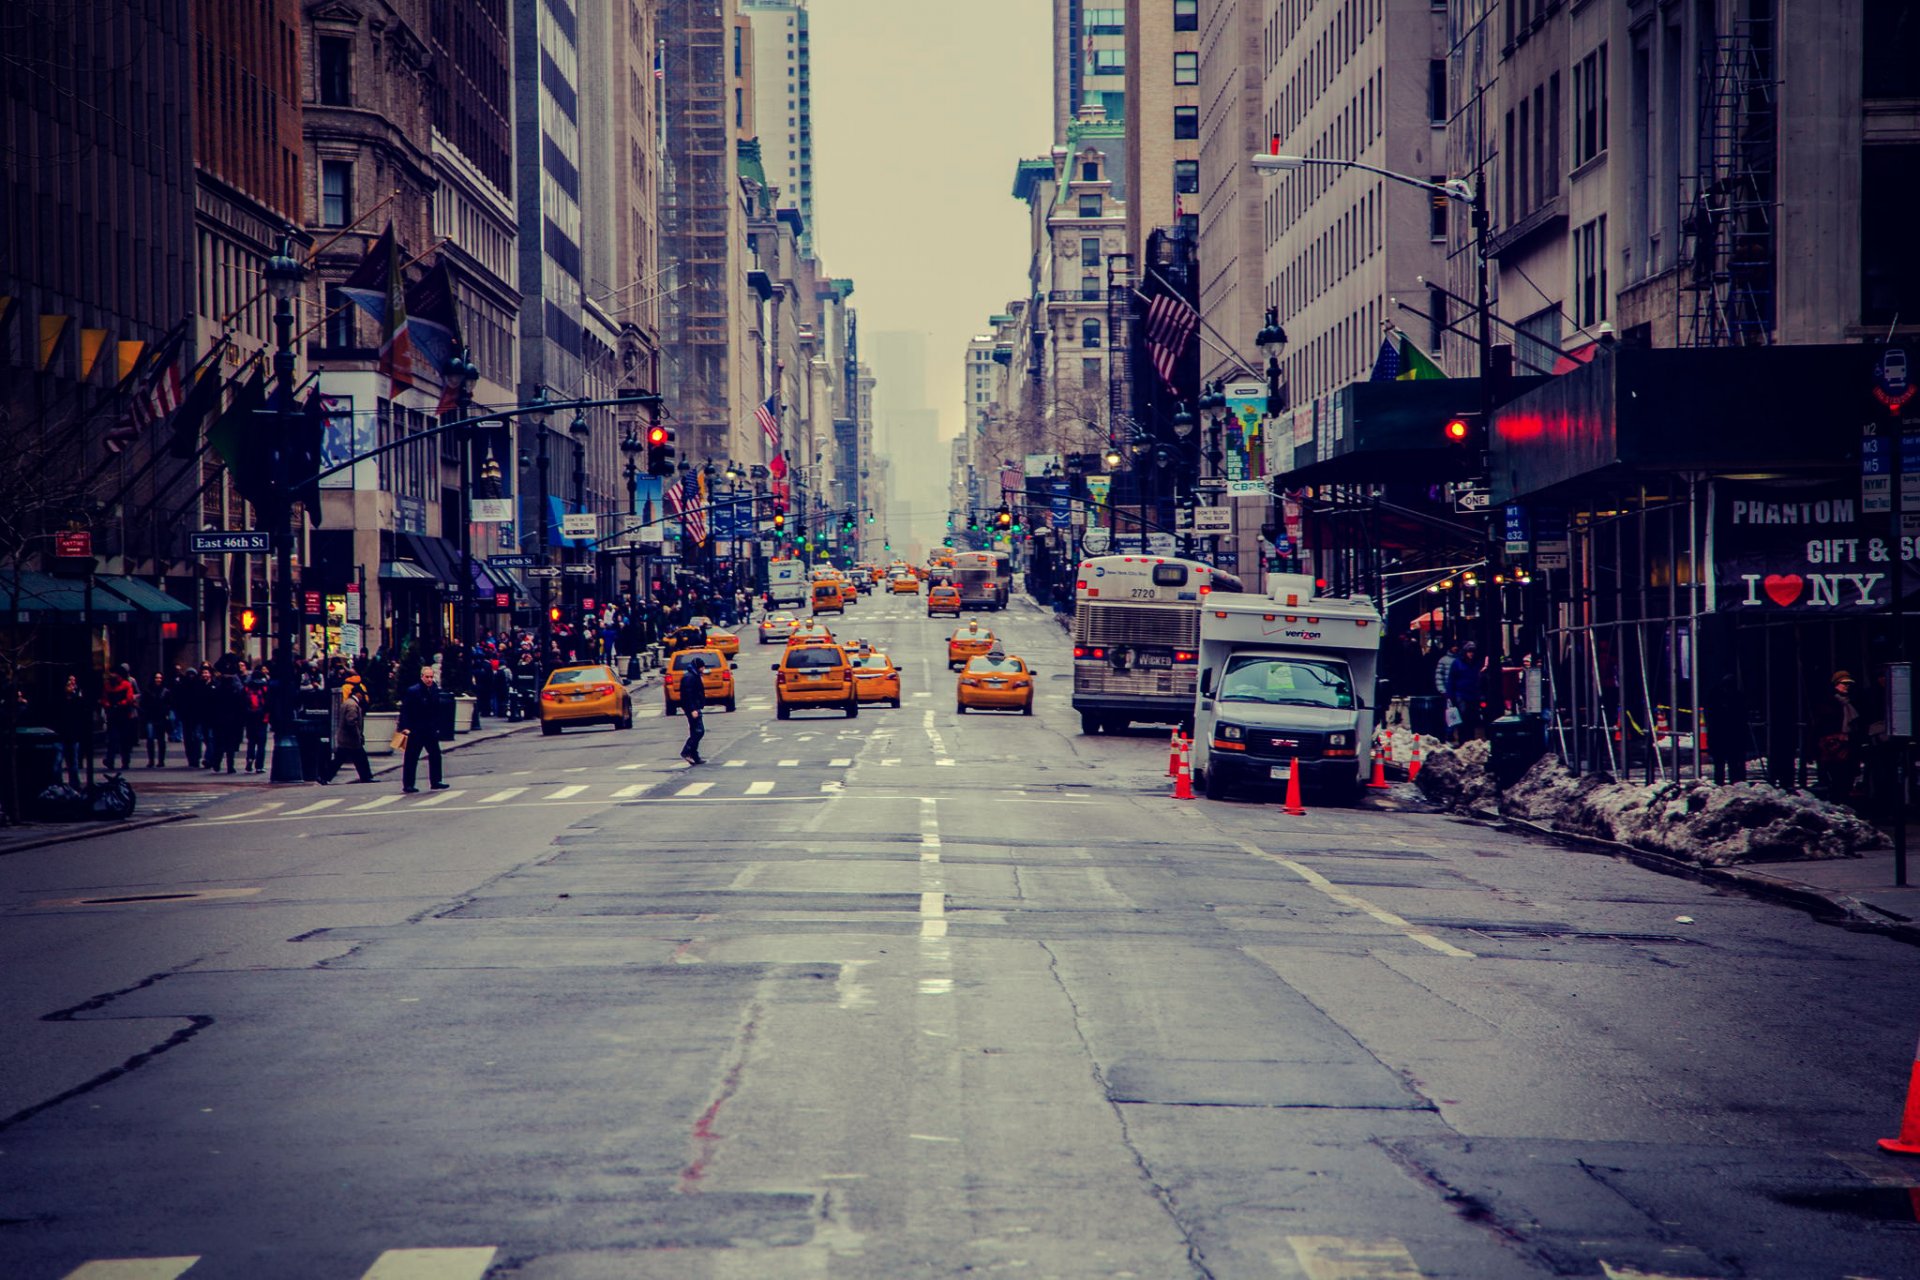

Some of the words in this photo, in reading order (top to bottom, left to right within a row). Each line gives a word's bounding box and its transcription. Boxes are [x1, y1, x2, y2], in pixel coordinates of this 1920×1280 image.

[1863, 422, 1877, 436] M2
[1863, 439, 1878, 453] M3
[1863, 458, 1880, 472] M5
[1864, 479, 1887, 490] NYMT
[1465, 496, 1485, 505] ONE
[1506, 507, 1518, 516] M1
[1732, 498, 1855, 525] PHANTOM
[1506, 519, 1519, 528] M4
[196, 537, 222, 548] East
[224, 537, 249, 548] 46th
[251, 536, 264, 547] St
[1806, 538, 1860, 564] GIFT
[1867, 537, 1891, 562] &
[1131, 588, 1155, 598] 2720
[1740, 573, 1762, 606] I
[1285, 629, 1321, 640] verizon
